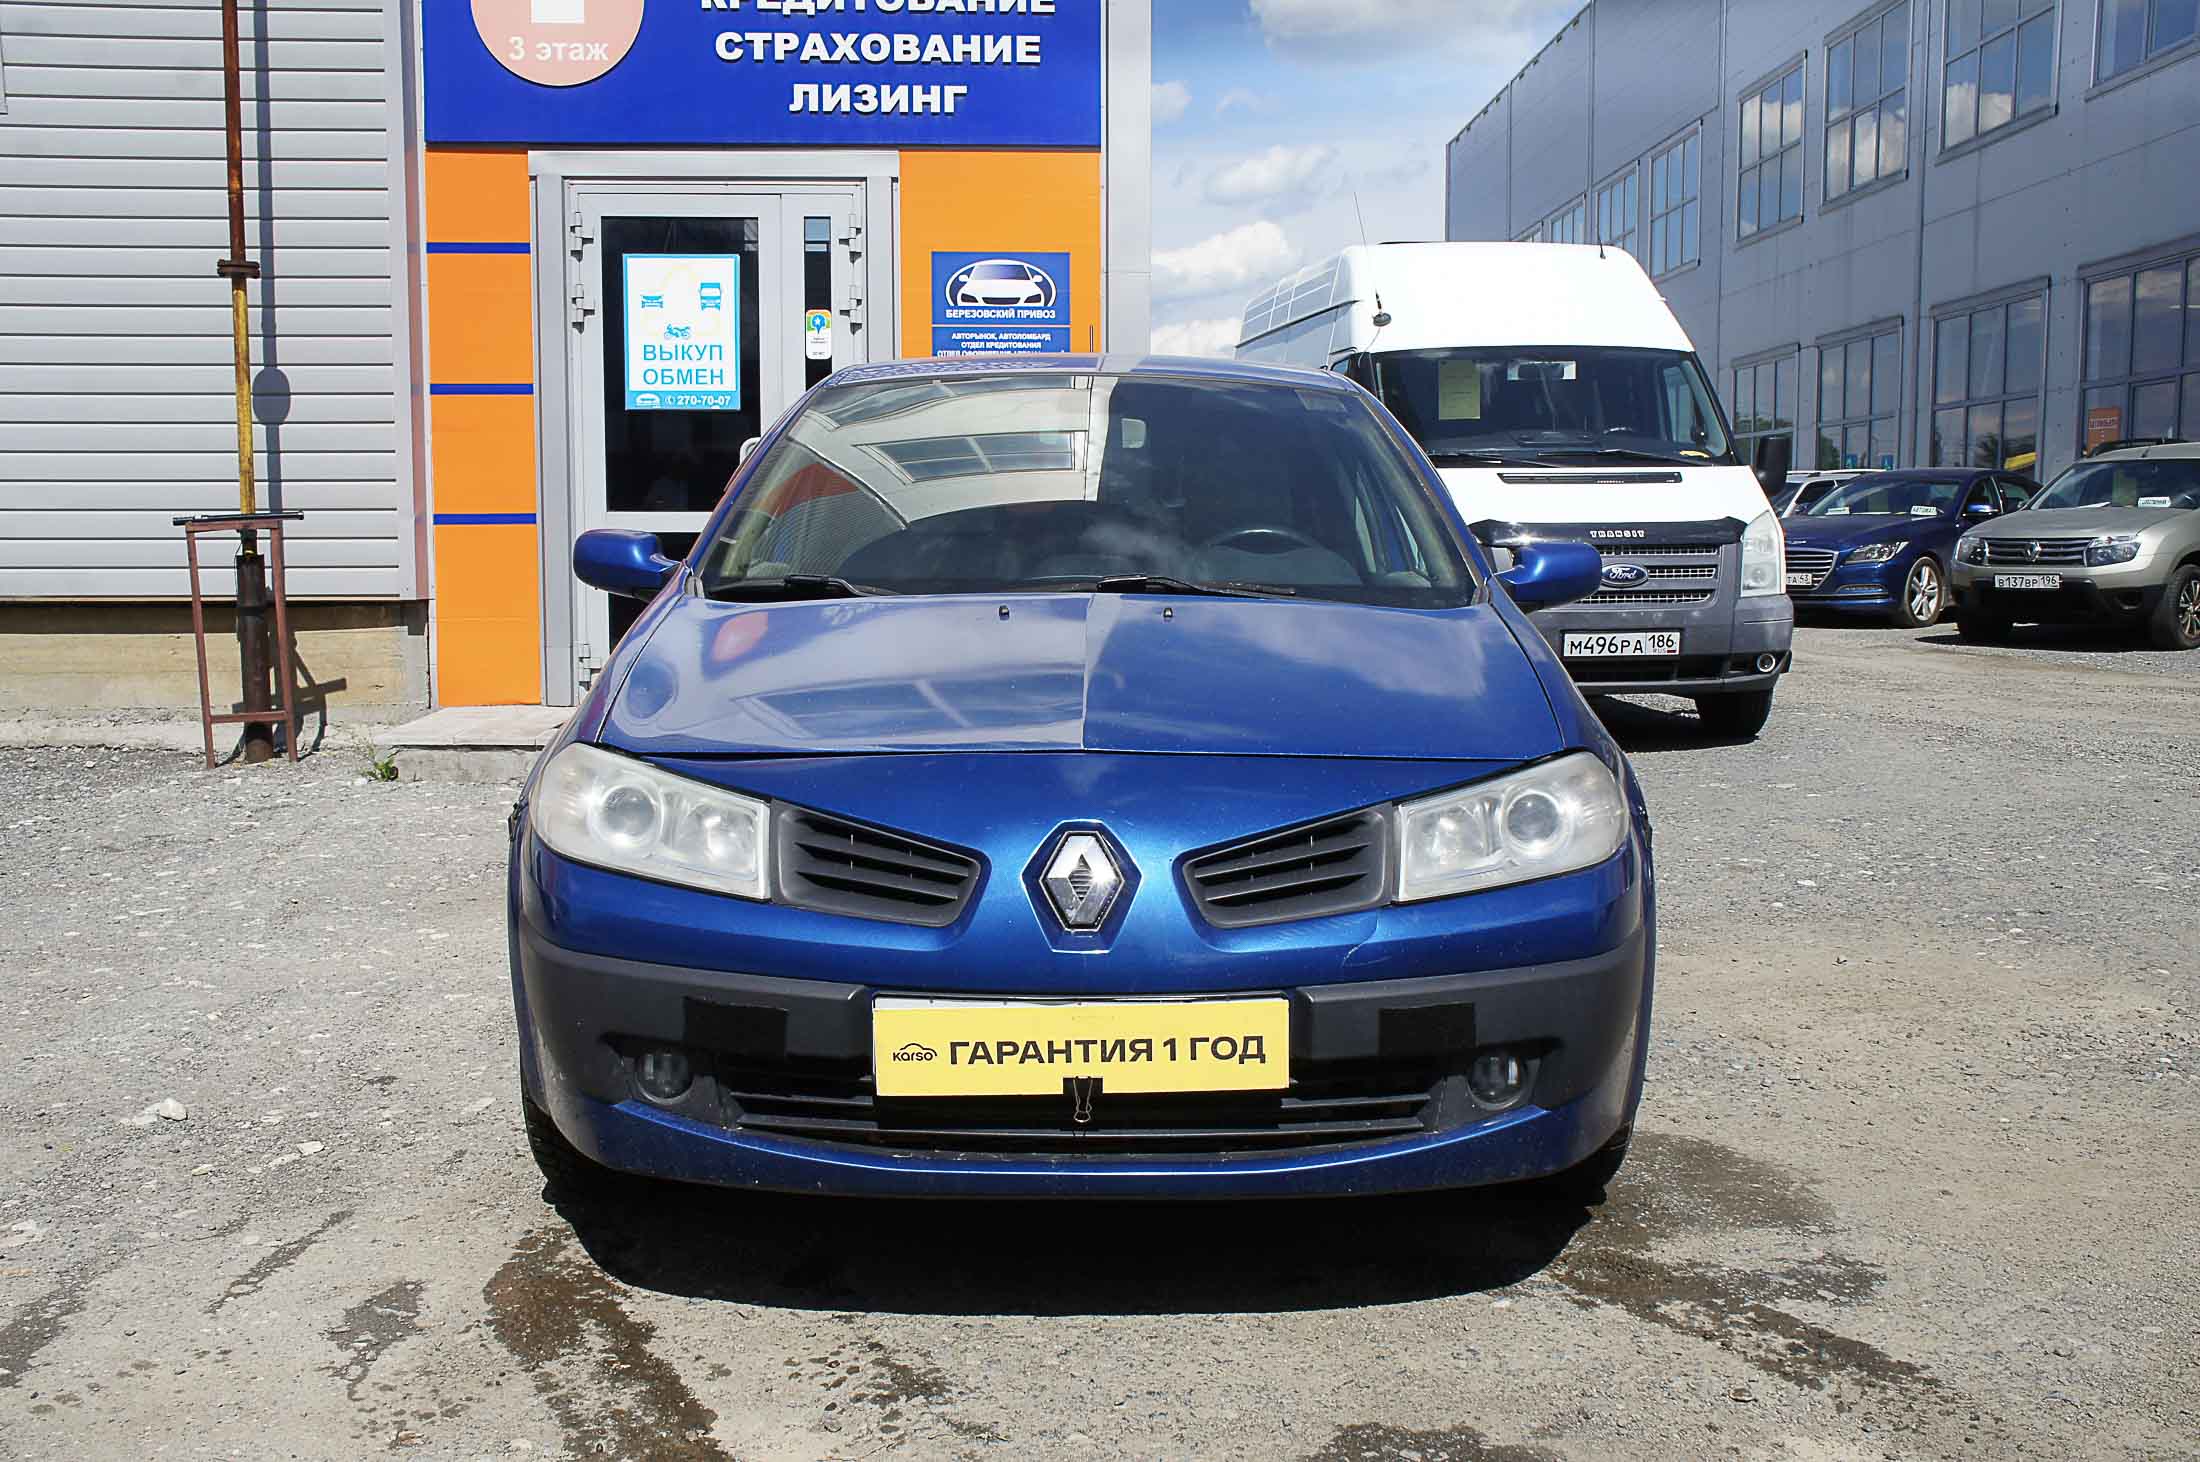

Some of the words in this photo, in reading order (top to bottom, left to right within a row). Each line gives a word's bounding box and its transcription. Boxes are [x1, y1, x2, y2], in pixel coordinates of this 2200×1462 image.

[509, 36, 526, 61] 3
[535, 42, 609, 61] этаж
[715, 31, 1041, 63] СТРАХОВАНИЕ
[789, 83, 968, 113] ЛИЗИНГ
[945, 308, 1015, 319] БЕРЕЗОВСКИЙ
[1017, 309, 1056, 319] ПРИВОЗ
[643, 344, 722, 361] ВЫКУП
[643, 368, 724, 385] ОБМЕН
[676, 395, 731, 405] 270-70-07
[1609, 567, 1637, 579] Ford
[2040, 575, 2057, 585] 196
[1569, 636, 1643, 654] М496РА
[1648, 634, 1675, 648] 186
[949, 1039, 1153, 1065] ГАРАНТИЯ
[1163, 1038, 1177, 1061] 1
[1190, 1035, 1266, 1065] ГОД
